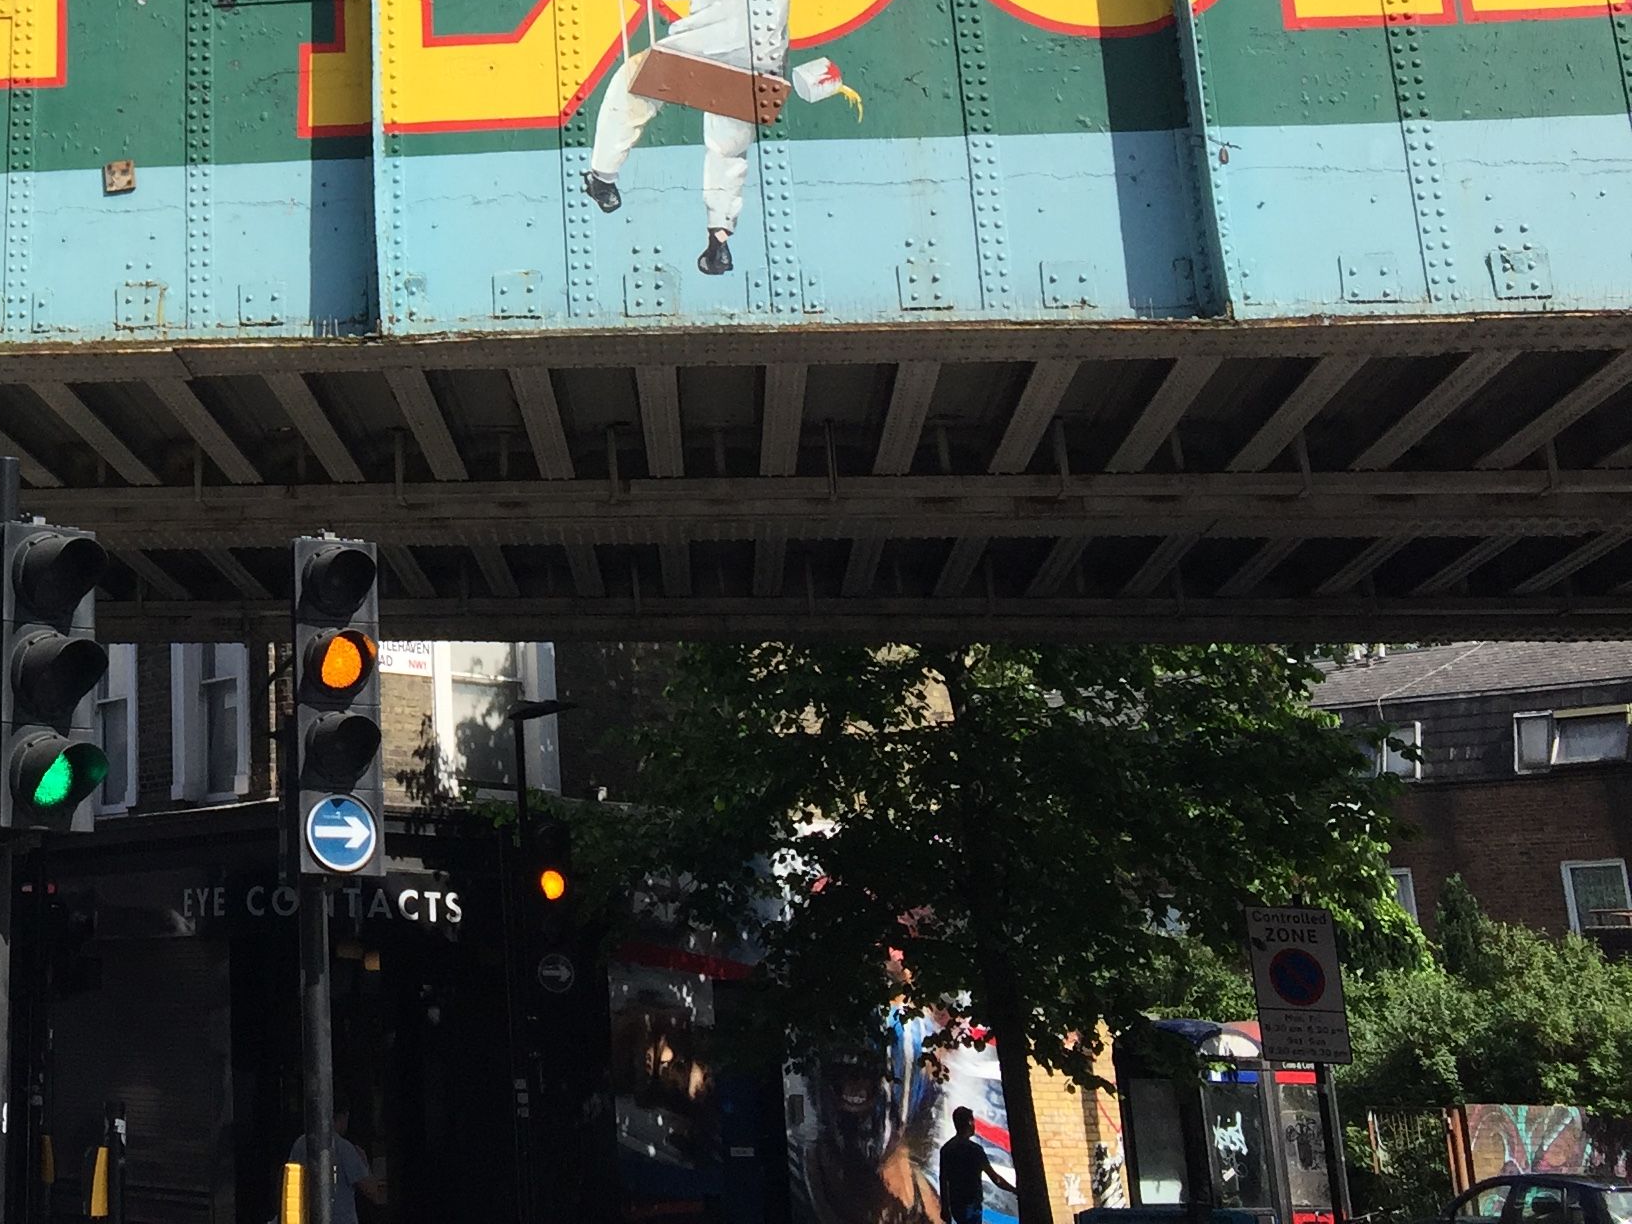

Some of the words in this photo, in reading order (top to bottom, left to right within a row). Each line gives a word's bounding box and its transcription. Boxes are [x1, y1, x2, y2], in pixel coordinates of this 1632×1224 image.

[408, 659, 427, 670] NW1
[183, 886, 226, 918] EYE
[1251, 909, 1328, 925] Controlled
[1265, 927, 1318, 944] ZONE
